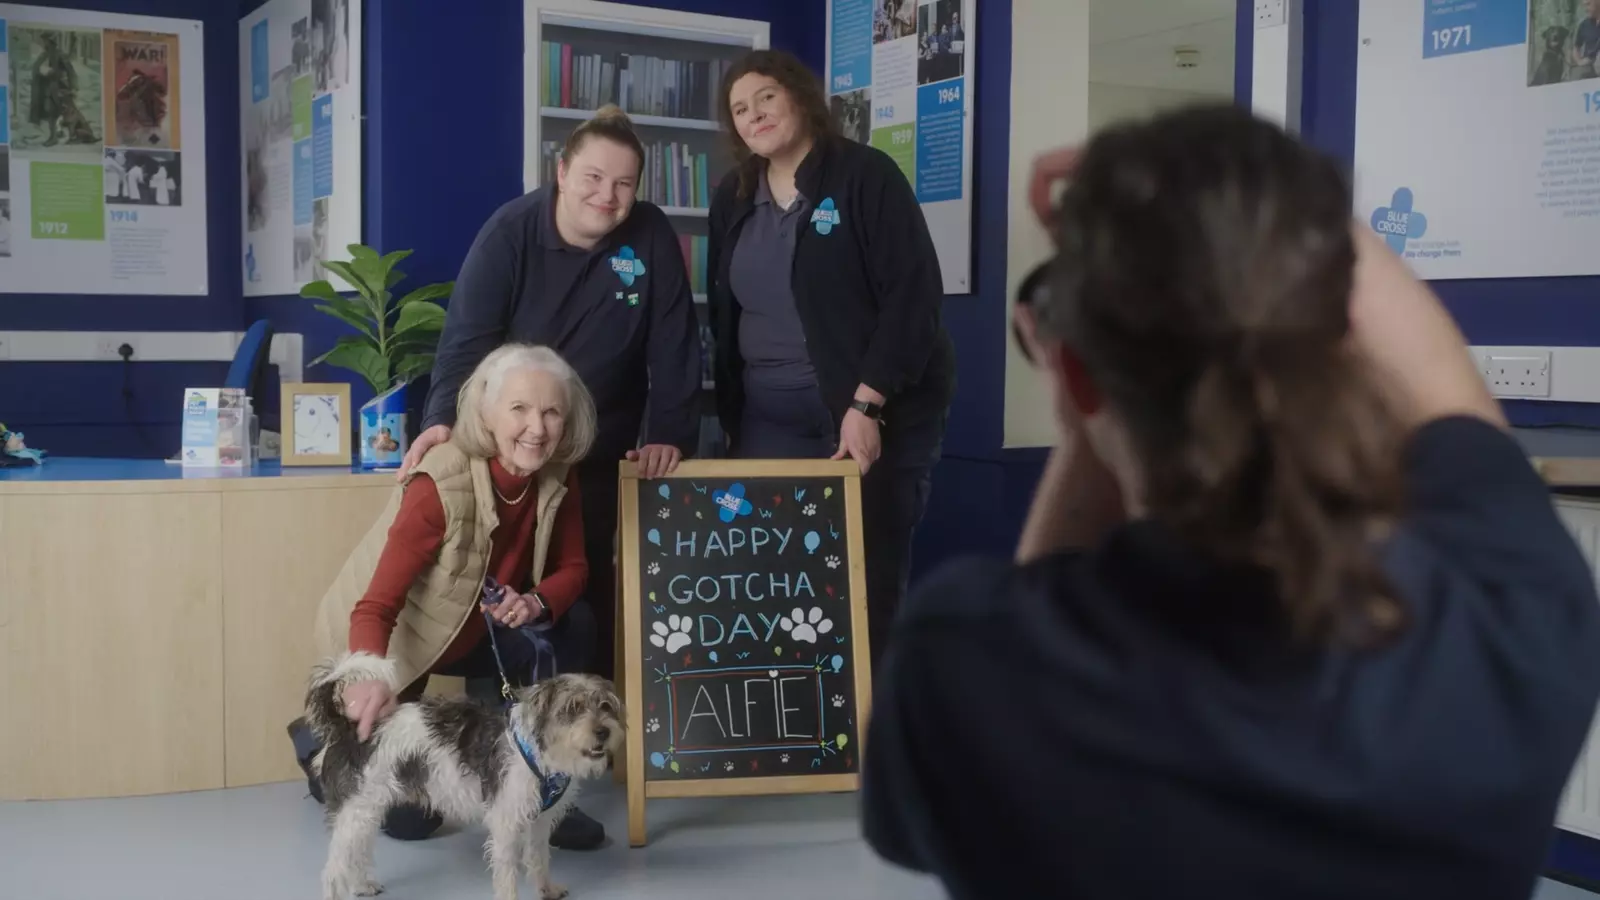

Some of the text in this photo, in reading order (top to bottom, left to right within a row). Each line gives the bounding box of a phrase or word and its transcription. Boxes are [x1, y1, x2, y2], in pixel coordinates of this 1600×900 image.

[1431, 24, 1472, 50] 1971
[121, 46, 164, 63] WAR!
[938, 85, 960, 105] 1964
[37, 221, 69, 235] 1912
[1376, 220, 1408, 235] CROSS
[1387, 210, 1409, 224] BLUE
[675, 526, 793, 558] HAPPY
[667, 570, 816, 604] GOTCHA
[698, 612, 781, 646] DAY
[680, 675, 813, 740] ALFIE
